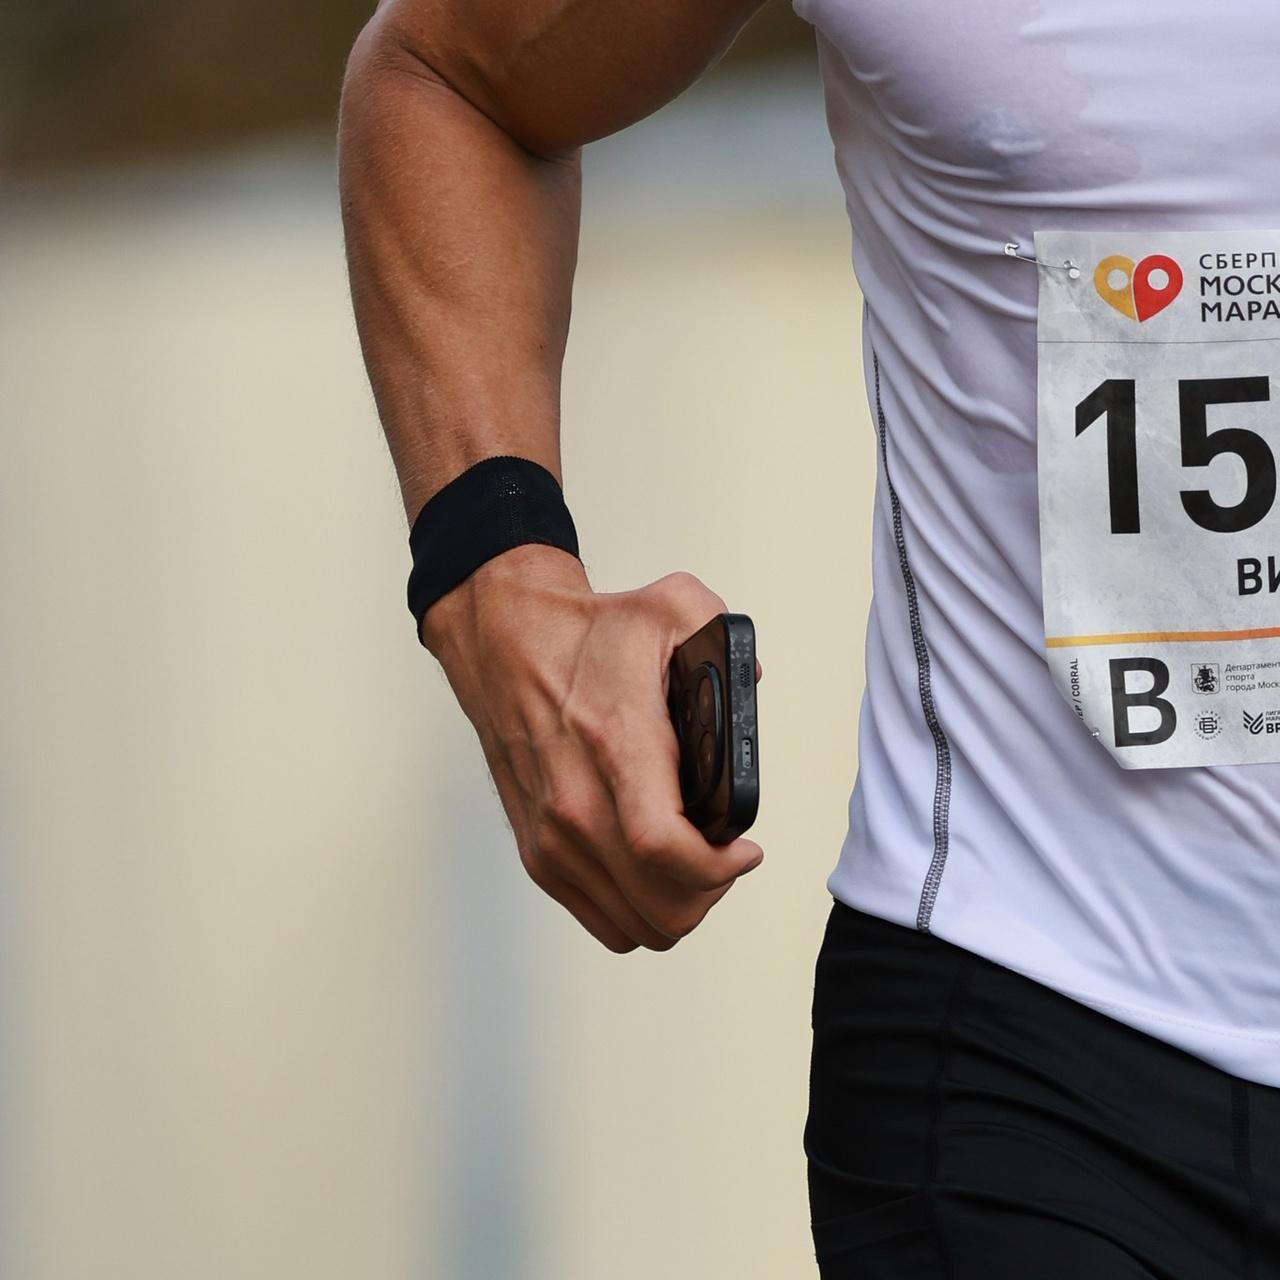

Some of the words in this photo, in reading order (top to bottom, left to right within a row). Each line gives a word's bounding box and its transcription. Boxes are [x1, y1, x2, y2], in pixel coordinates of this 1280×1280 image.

[1070, 658, 1080, 697] CORRAL
[1225, 674, 1255, 683] спорта
[1226, 684, 1256, 693] города
[1108, 656, 1178, 748] B
